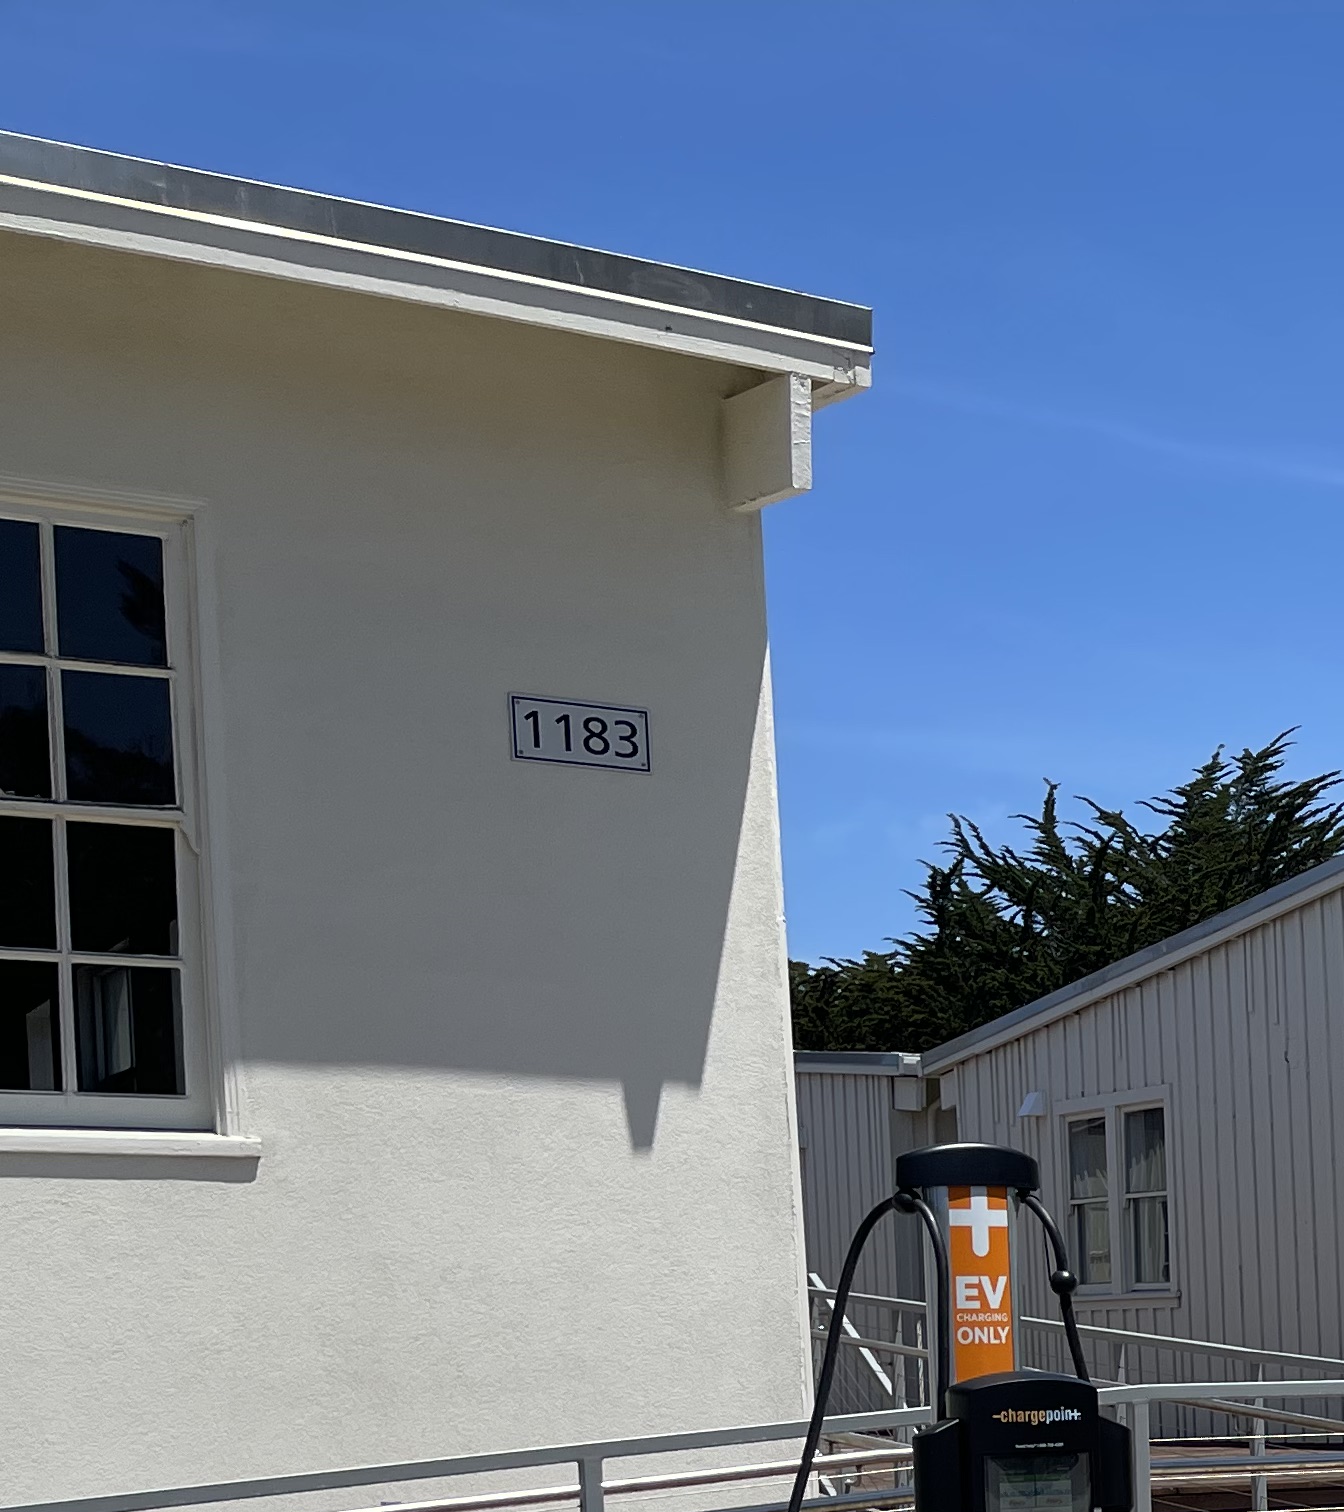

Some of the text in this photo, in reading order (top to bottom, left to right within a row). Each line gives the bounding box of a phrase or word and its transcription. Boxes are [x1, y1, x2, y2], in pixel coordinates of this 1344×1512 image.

[523, 710, 639, 759] 1183
[955, 1275, 1008, 1309] EV
[956, 1312, 1009, 1322] CHARGING
[956, 1326, 1010, 1345] ONLY
